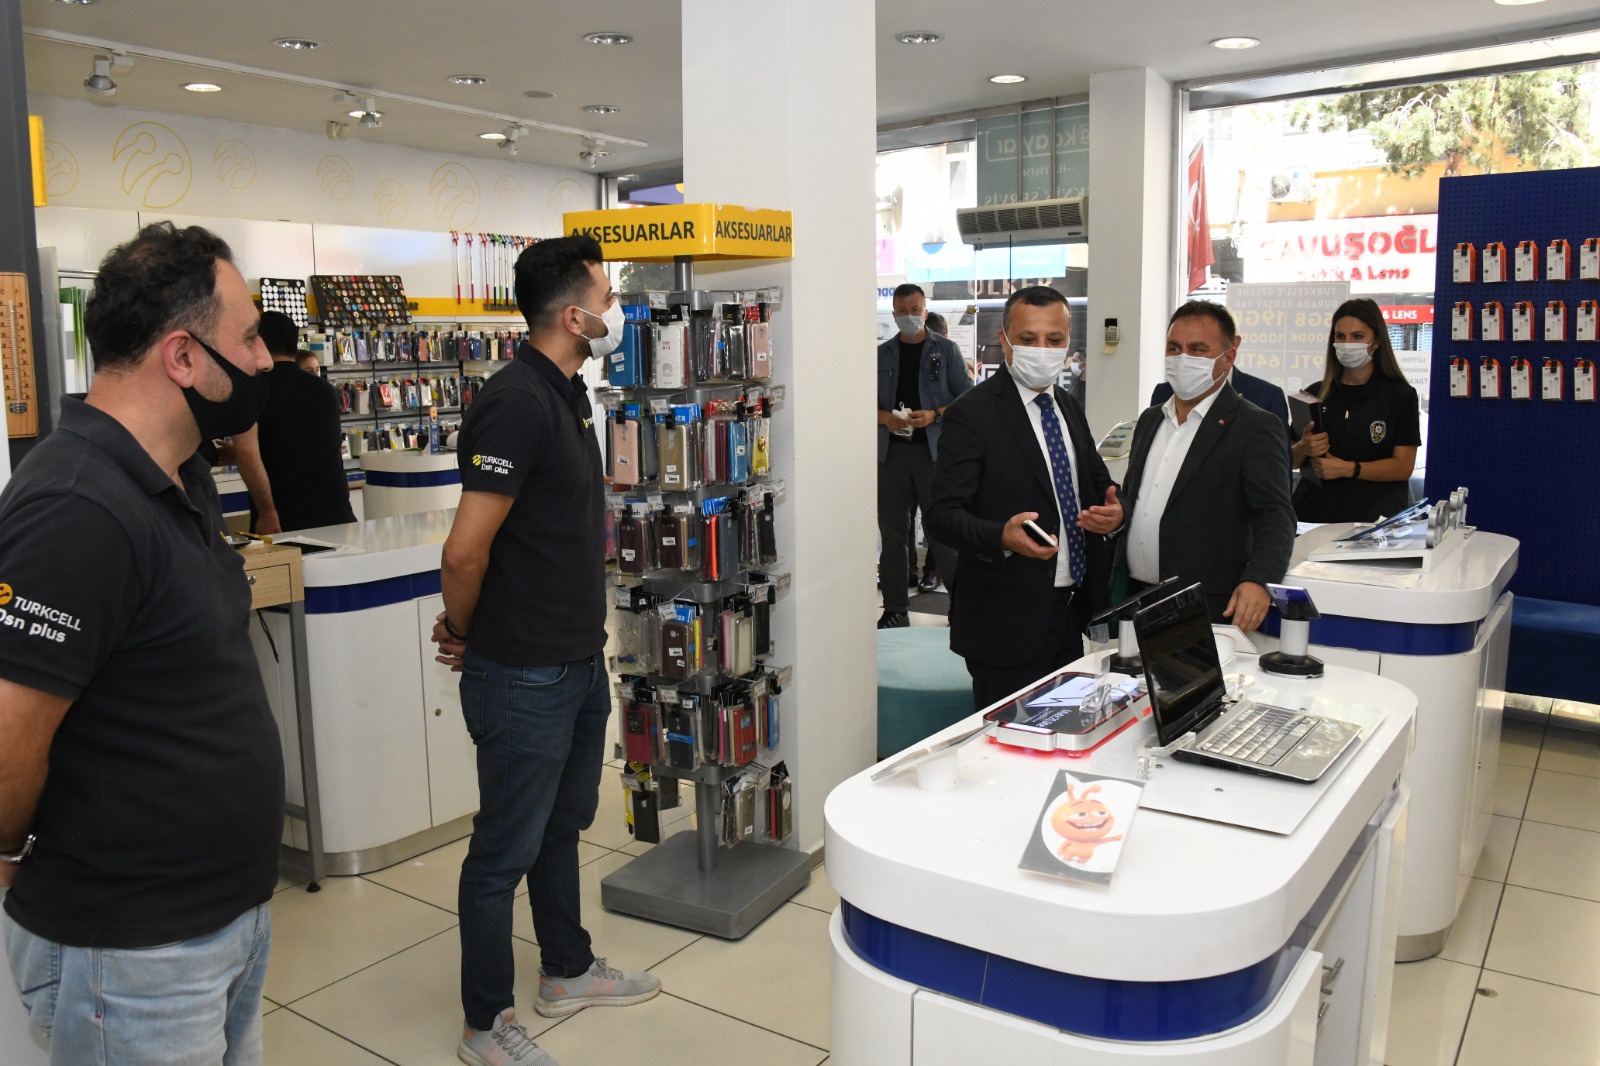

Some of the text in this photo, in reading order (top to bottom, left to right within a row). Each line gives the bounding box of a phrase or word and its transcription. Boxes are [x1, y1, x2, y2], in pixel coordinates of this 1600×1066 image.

[715, 220, 792, 243] AKSESUARLAR
[1351, 267, 1363, 280] &
[1368, 265, 1410, 280] Lens
[1392, 310, 1418, 320] LENS
[481, 455, 514, 469] TURKCELL
[14, 596, 82, 632] TURKCELL
[29, 622, 67, 643] plus
